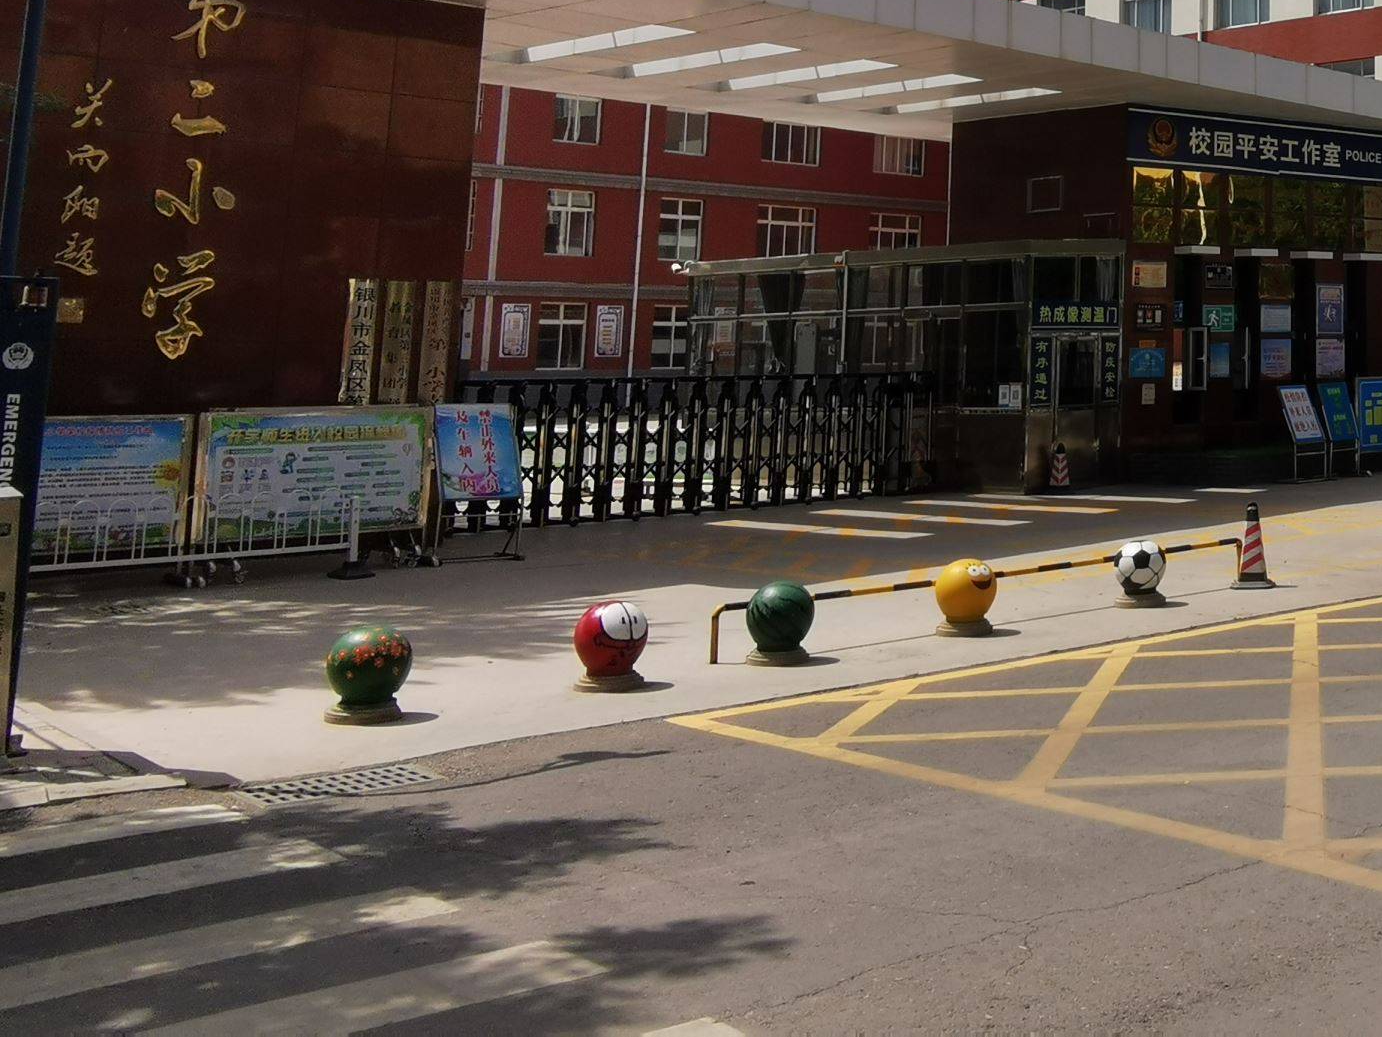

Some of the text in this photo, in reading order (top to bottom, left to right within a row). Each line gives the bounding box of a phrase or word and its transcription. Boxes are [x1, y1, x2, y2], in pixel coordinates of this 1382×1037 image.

[1189, 126, 1382, 168] 校园平安工作室 POLICE
[1039, 305, 1118, 324] 热成像测温门
[1034, 340, 1049, 401] 有序通过
